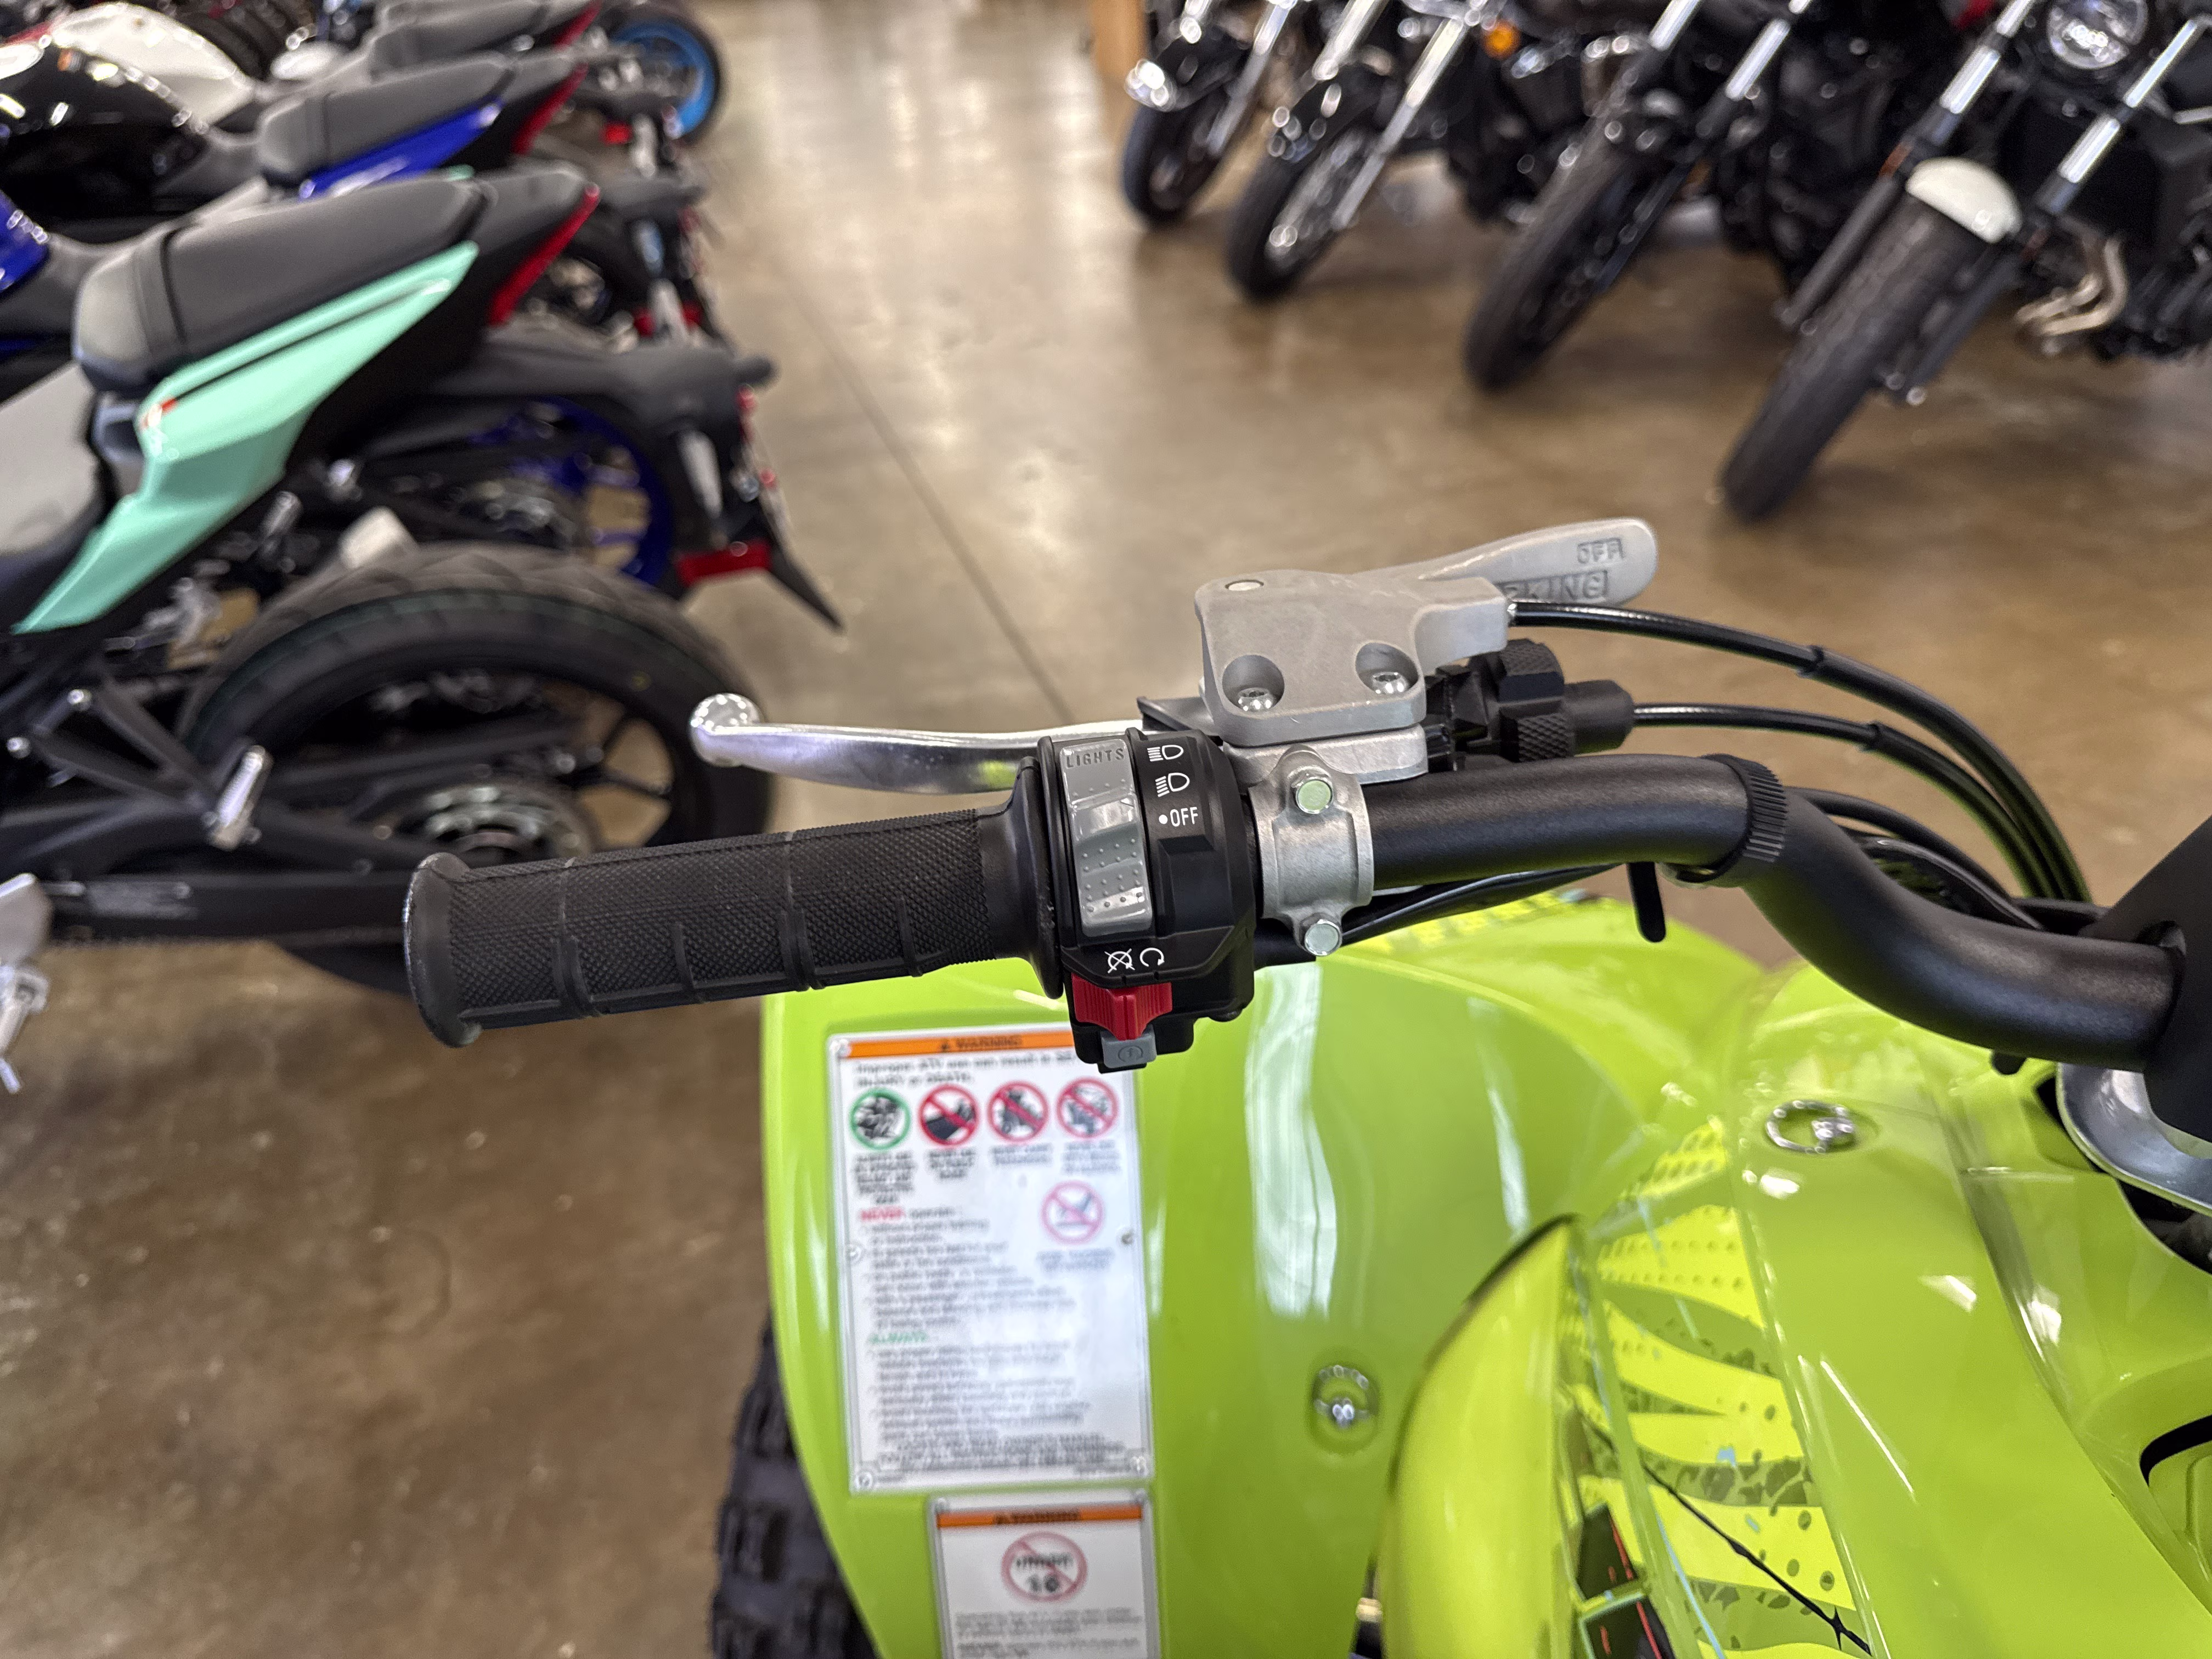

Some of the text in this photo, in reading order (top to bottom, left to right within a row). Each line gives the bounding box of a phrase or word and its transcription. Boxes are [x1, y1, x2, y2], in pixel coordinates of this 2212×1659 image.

[1577, 539, 1621, 564] OFF
[1066, 747, 1124, 768] LIGHTS
[1170, 806, 1198, 827] OFF
